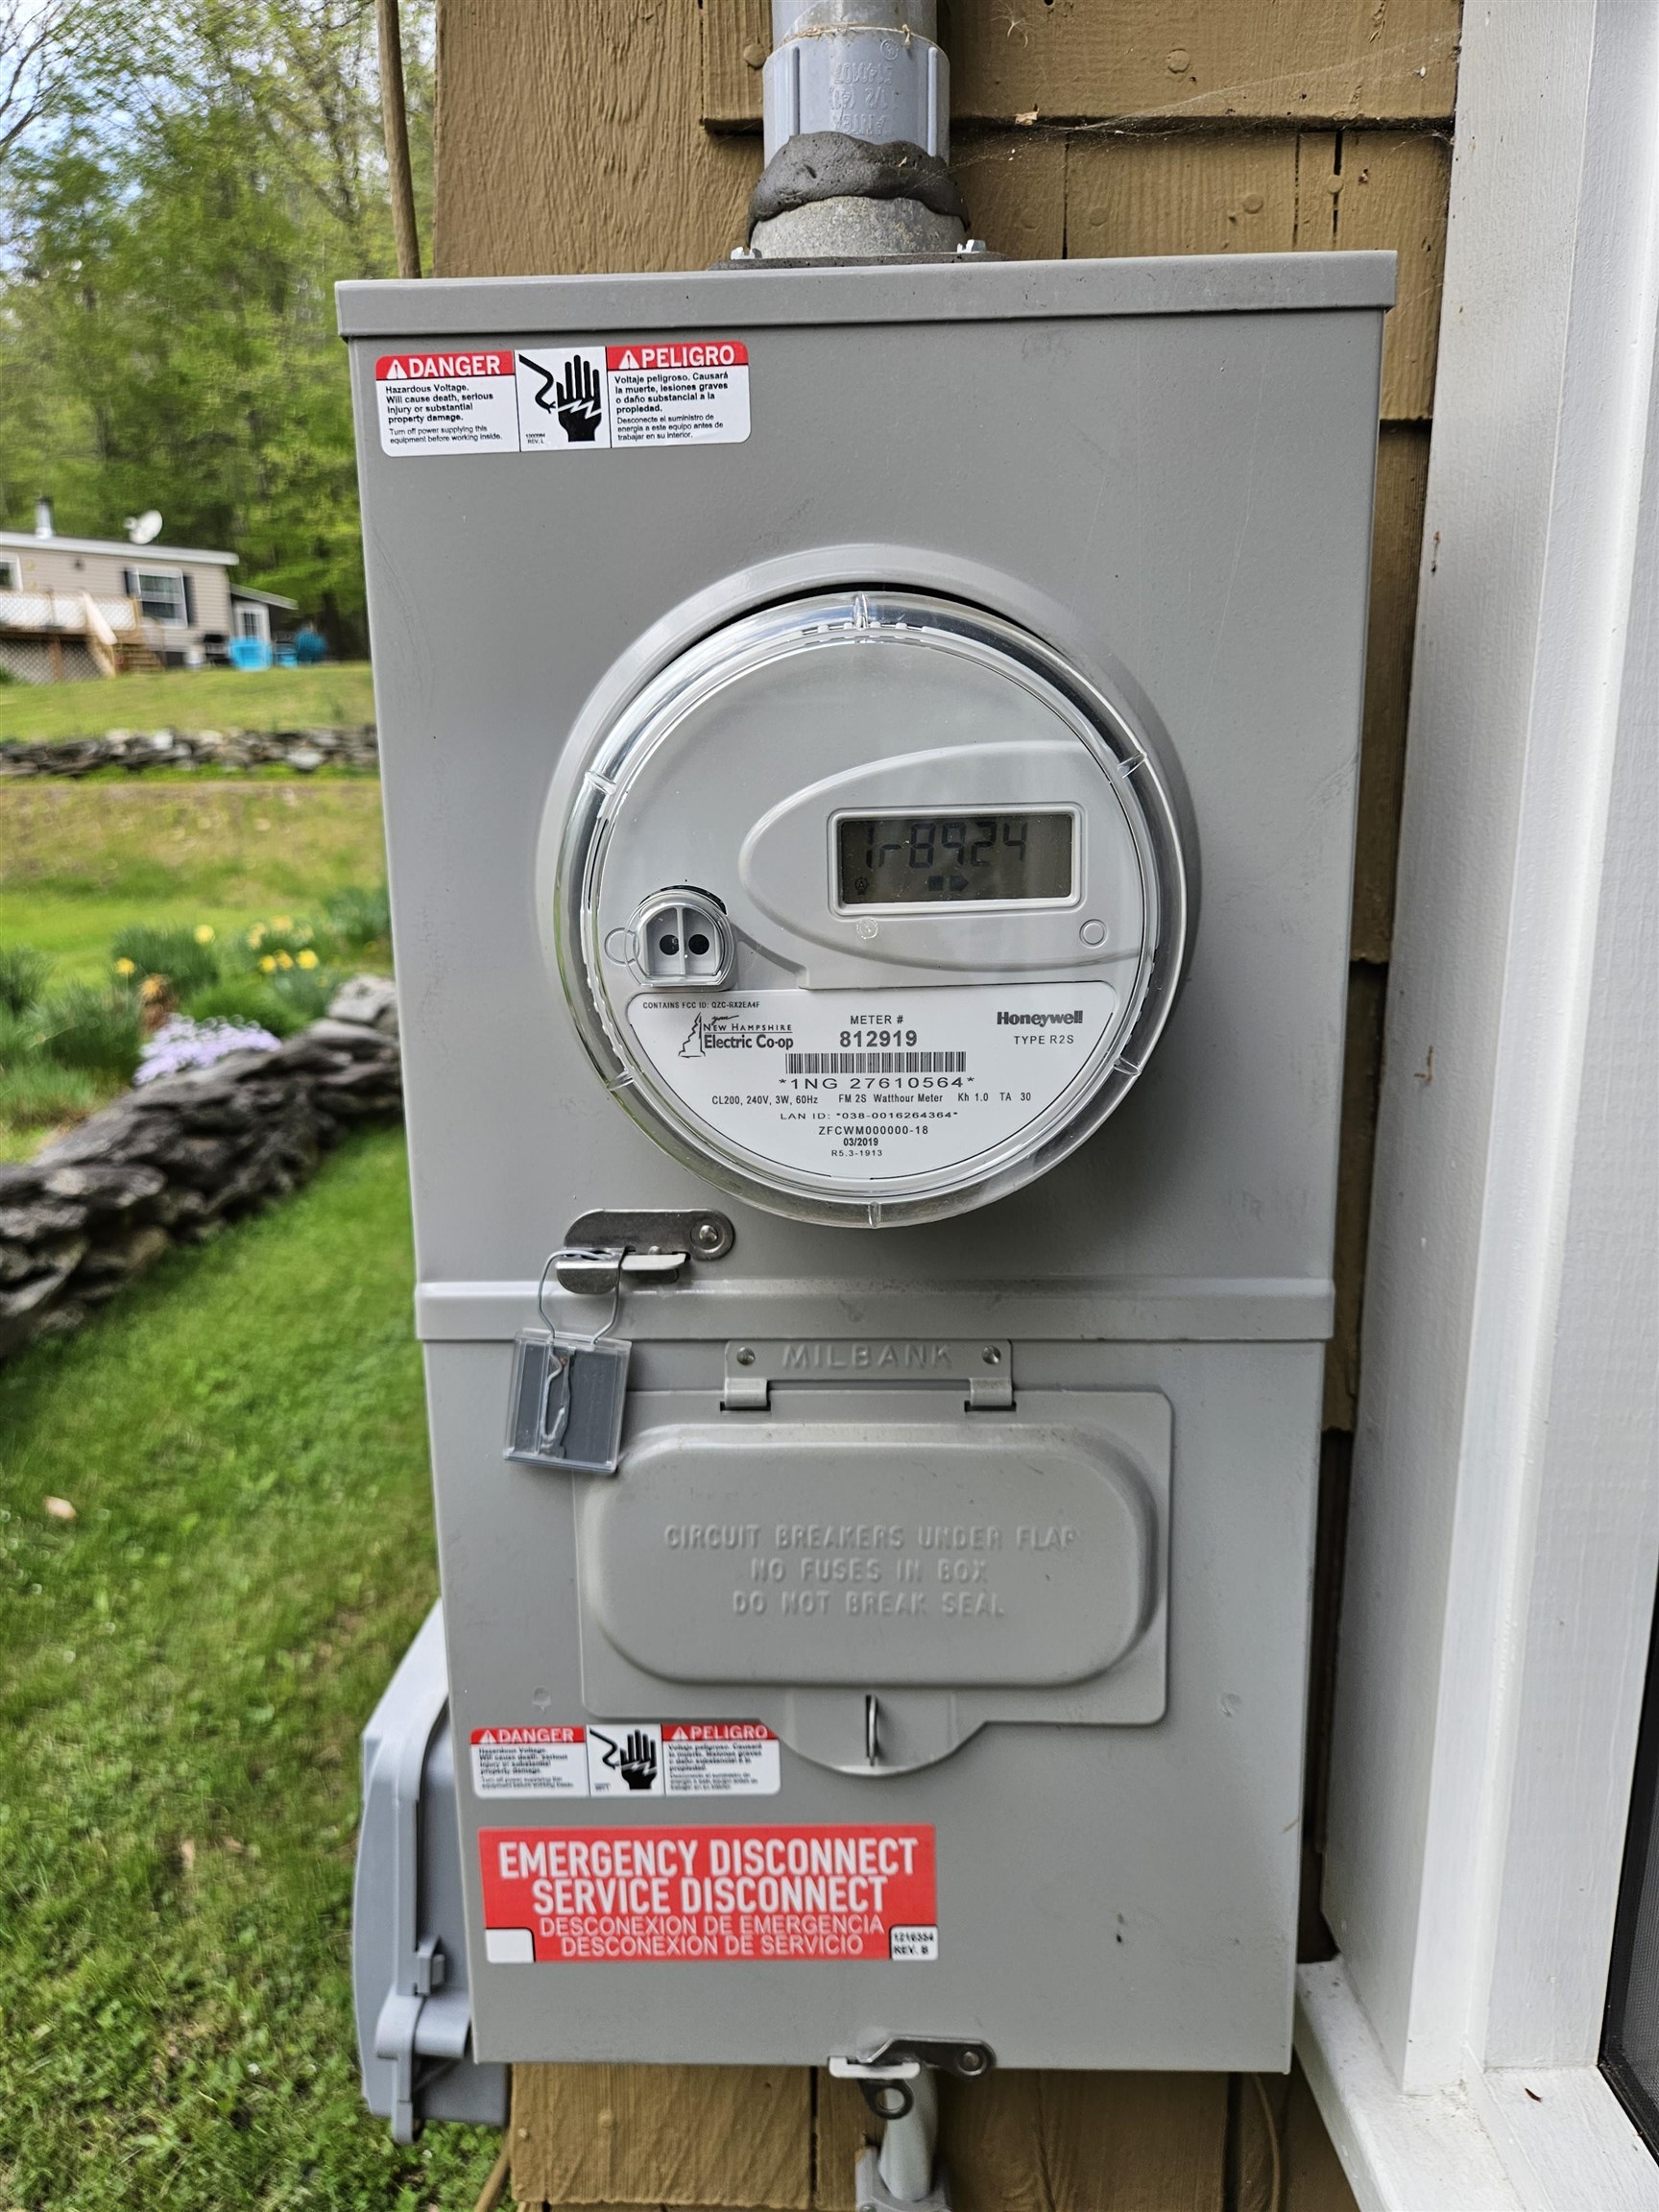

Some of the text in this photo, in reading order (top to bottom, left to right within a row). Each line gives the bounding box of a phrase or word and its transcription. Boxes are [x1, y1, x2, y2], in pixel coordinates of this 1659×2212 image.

[641, 345, 735, 369] PELIGRO
[408, 355, 500, 378] DANGER
[614, 372, 729, 386] Voltaje peligroso. Causará
[386, 384, 469, 394] Hazardous Voltage.
[625, 385, 659, 394] muerte,
[660, 383, 697, 392] lesiones
[699, 383, 729, 392] graves
[386, 396, 402, 404] Will
[433, 394, 460, 402] death,
[624, 395, 645, 403] daño
[647, 393, 698, 402] substancial
[425, 403, 473, 412] substantial
[616, 404, 662, 415] propiedad.
[388, 414, 464, 425] property damage.
[390, 427, 405, 436] Turn
[441, 426, 473, 435] supplying
[617, 433, 644, 442] trabajar
[390, 436, 426, 445] equipment
[451, 433, 479, 442] working
[850, 1015, 904, 1025] METER #
[997, 1010, 1083, 1027] Honeywell
[704, 1034, 753, 1049] Electric
[839, 1029, 918, 1047] 812919
[1014, 1035, 1074, 1046] TYPE R2S
[711, 1092, 1031, 1106] CL200, 240V, 3W, 60Hz FM 2S Watthour Meter Kh 1.0 TA 30
[819, 1125, 928, 1135] ZFCWM000000-18
[843, 1138, 878, 1146] 03/2019
[782, 1344, 952, 1368] MILBANK
[664, 1524, 1076, 1550] CIRCUIT BREAKERS UNDER FLAP
[751, 1556, 988, 1583] NO FUSES IN BOX
[733, 1590, 1006, 1618] DO NOT BREAK SEAL
[499, 1727, 574, 1743] DANGER
[690, 1725, 768, 1740] PELIGRO
[498, 1837, 919, 1879] EMERGENCY DISCONNECT
[532, 1875, 888, 1915] SERVICE DISCONNECT
[540, 1914, 884, 1937] DESCONEXION DE EMERGENCIA
[562, 1934, 863, 1957] DESCONEXION DE SERVICIO
